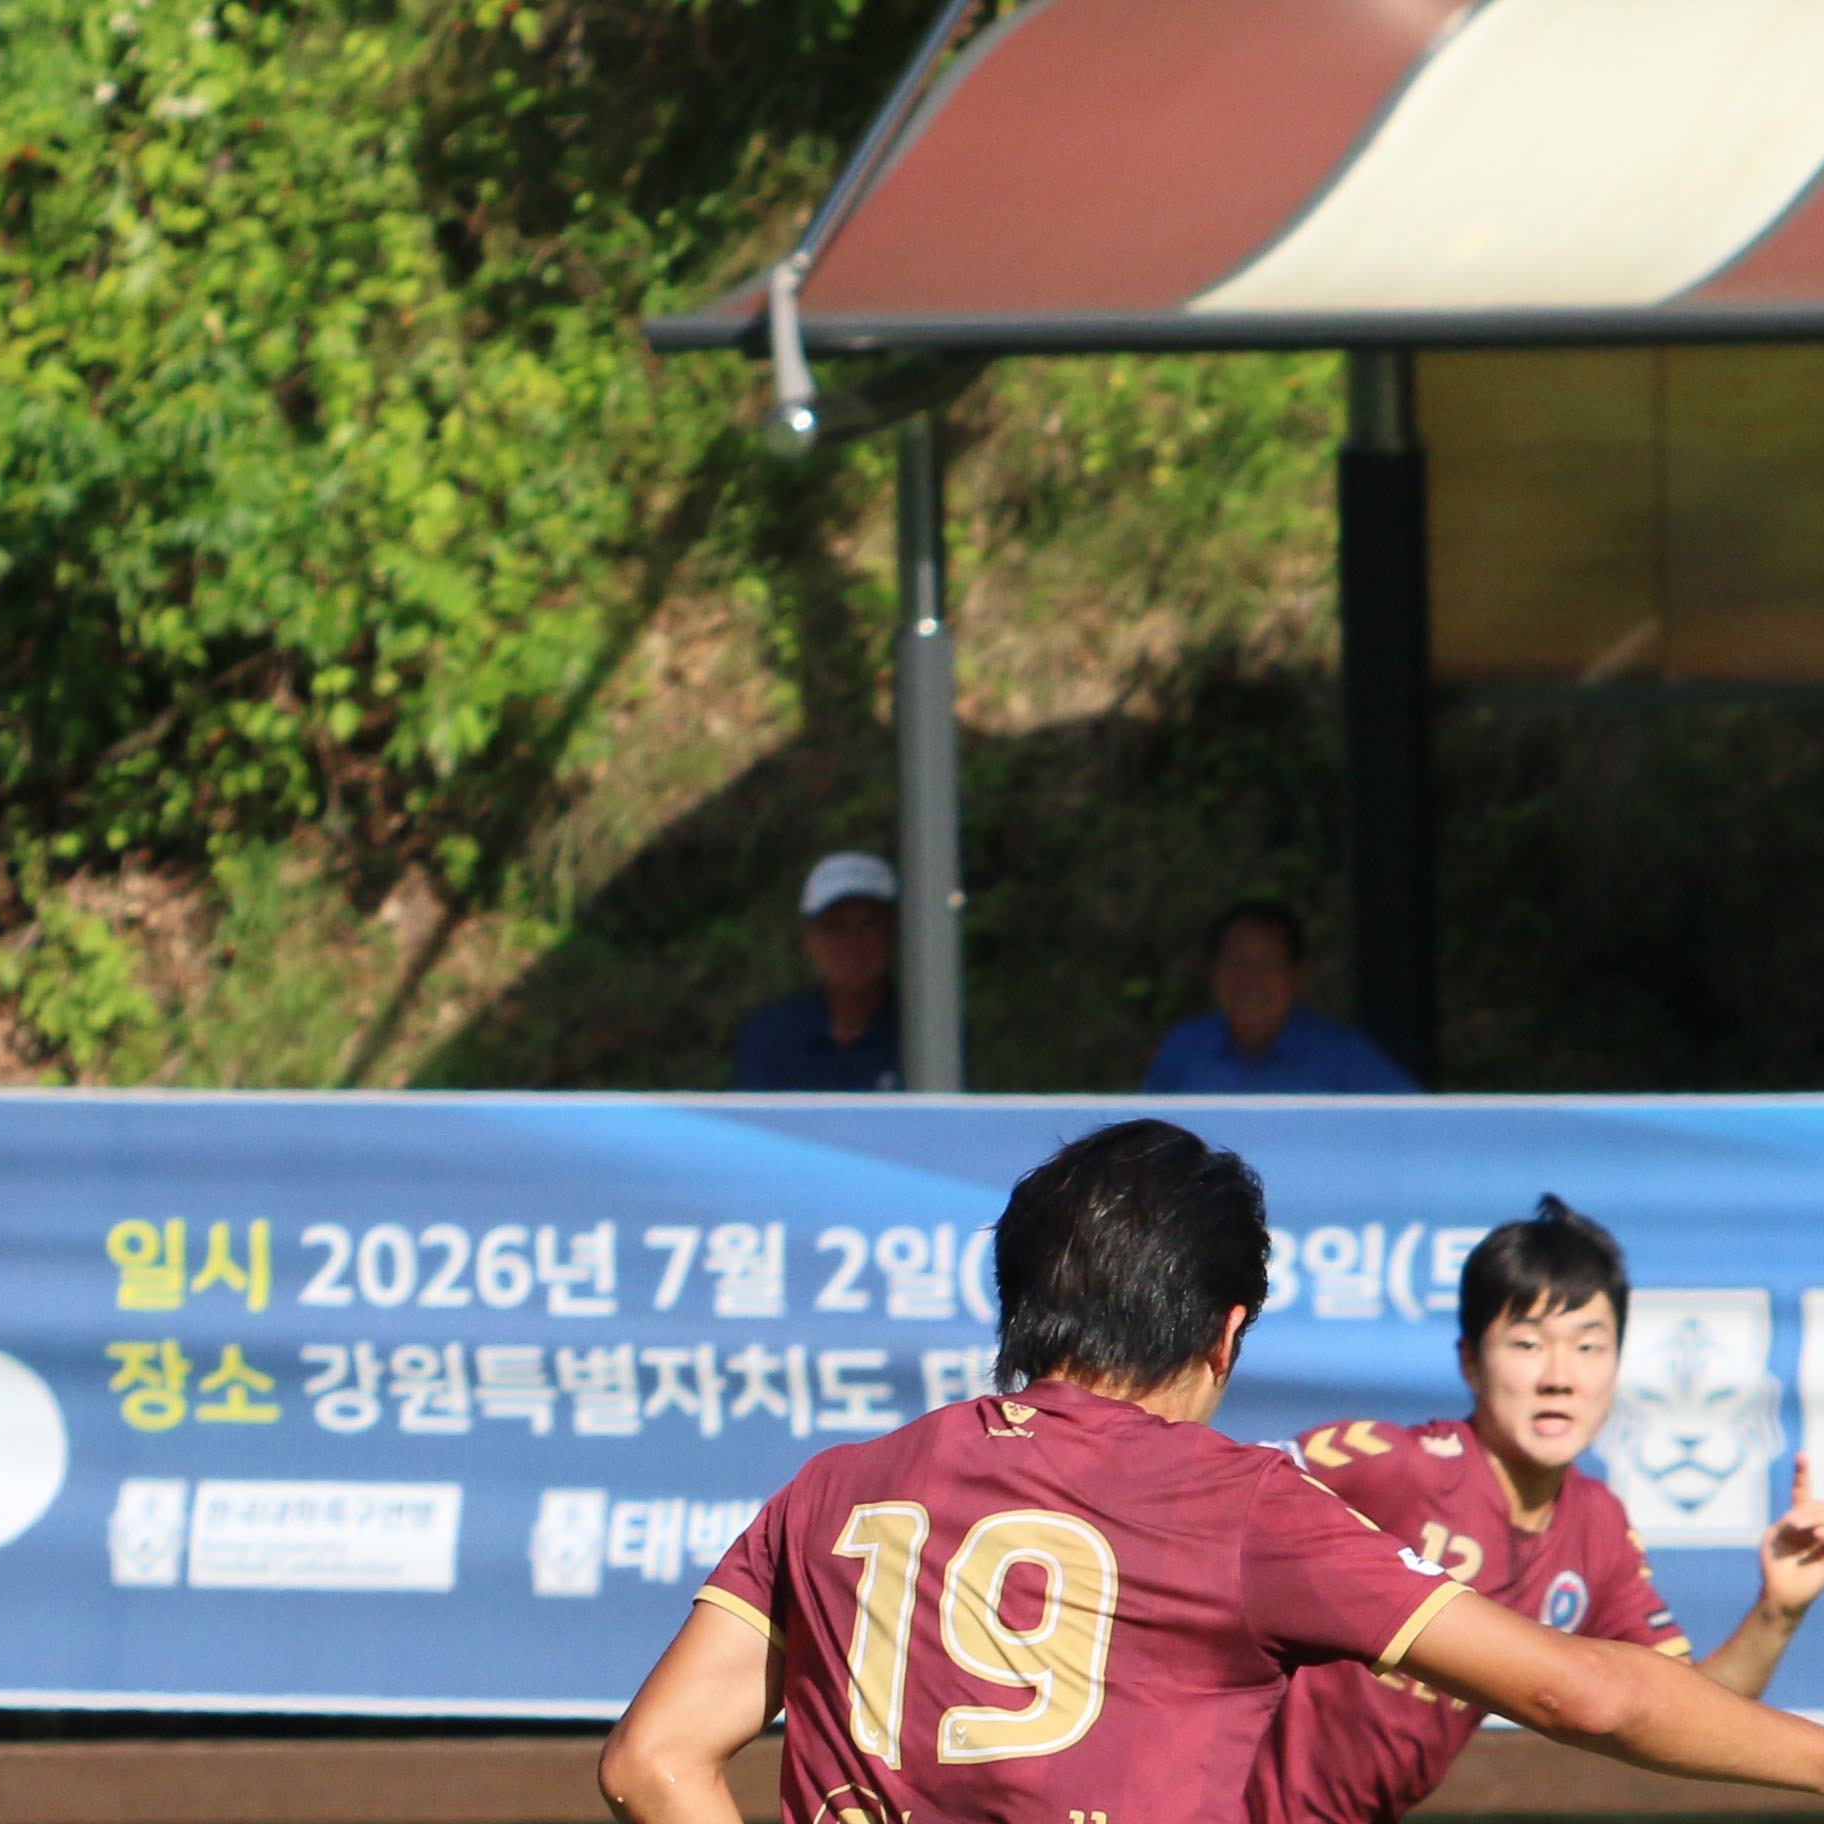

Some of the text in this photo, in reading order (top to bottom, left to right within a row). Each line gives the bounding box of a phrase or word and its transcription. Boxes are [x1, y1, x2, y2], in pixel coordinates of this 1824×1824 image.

[107, 1220, 997, 1323] 일시 2026년 7월 2일(
[107, 1342, 281, 1433] 장소
[304, 1343, 903, 1438] 강원특별자치도
[832, 1500, 1119, 1770] 19
